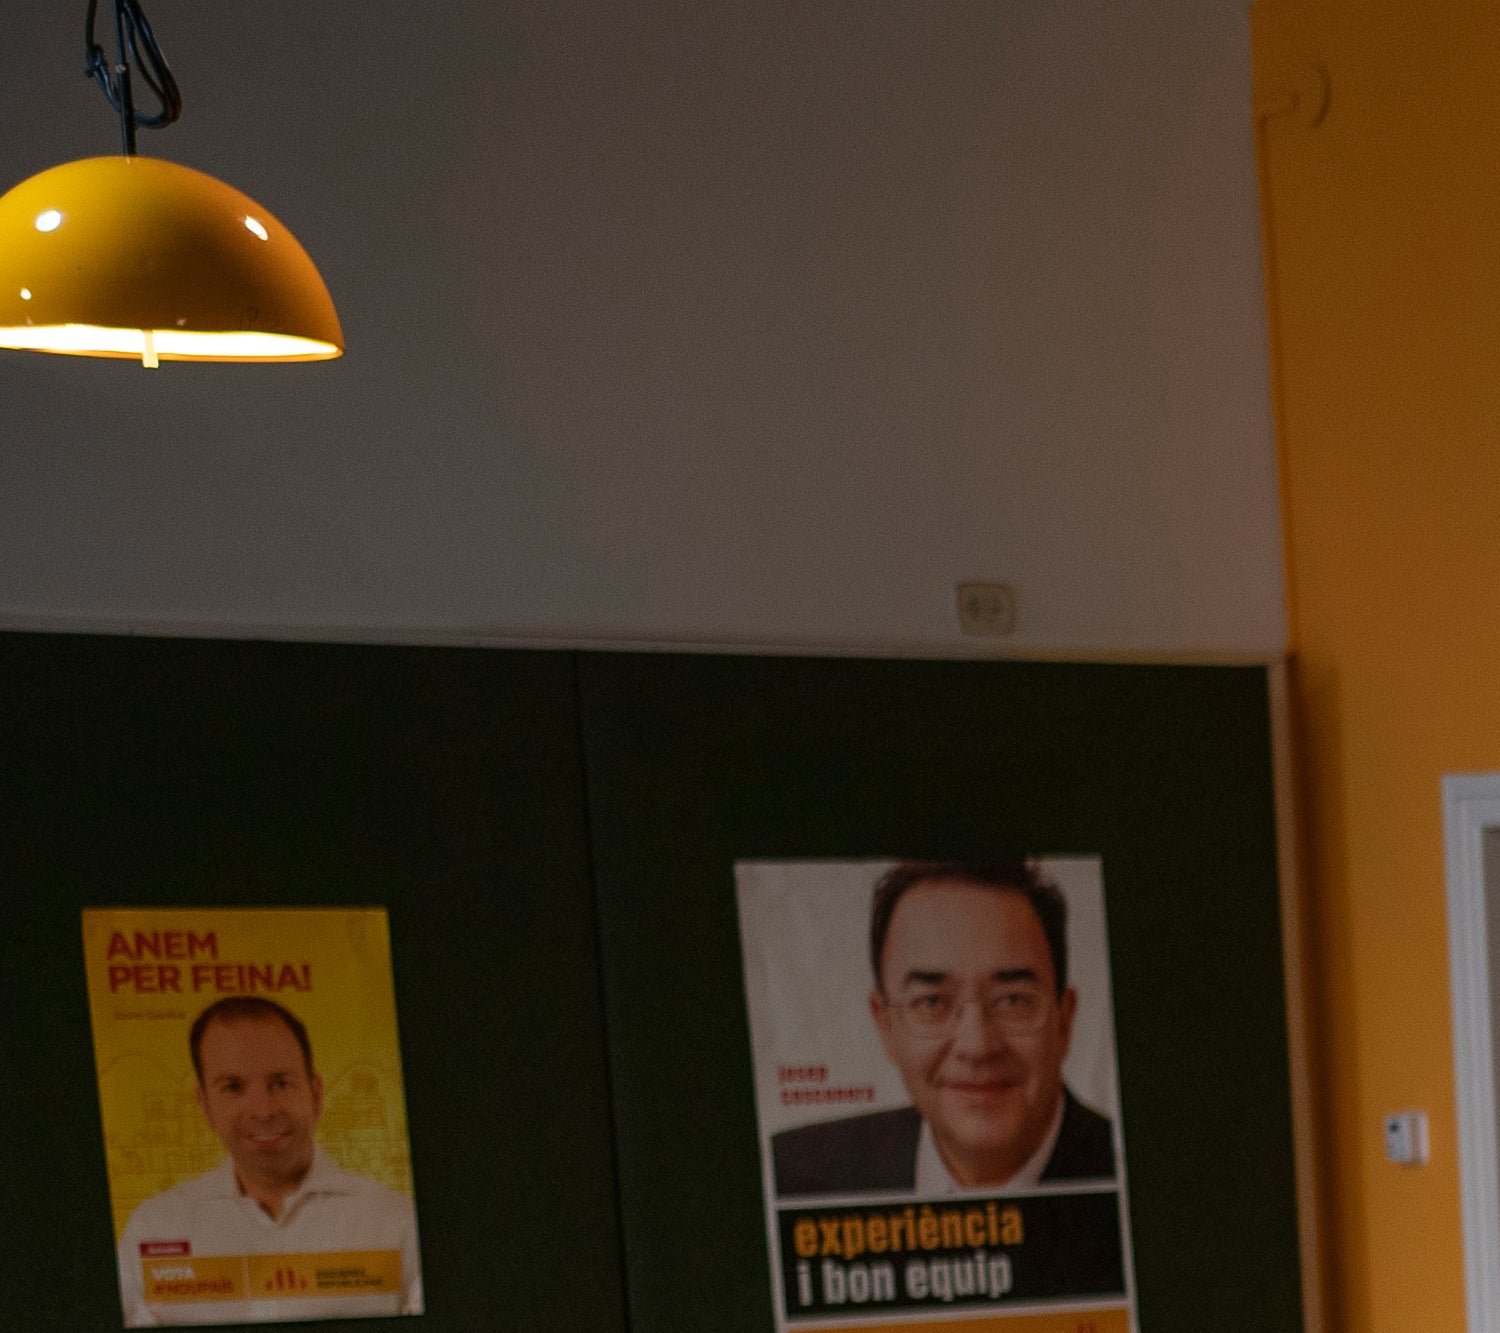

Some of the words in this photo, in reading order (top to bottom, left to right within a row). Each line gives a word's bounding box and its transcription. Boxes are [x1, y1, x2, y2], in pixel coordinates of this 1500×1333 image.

[107, 931, 218, 960] ANEM
[108, 964, 183, 993] PER
[191, 962, 312, 993] FEINA!
[793, 1200, 1025, 1260] experiència
[797, 1261, 813, 1307] i
[821, 1258, 896, 1305] bon
[905, 1250, 1014, 1302] equip
